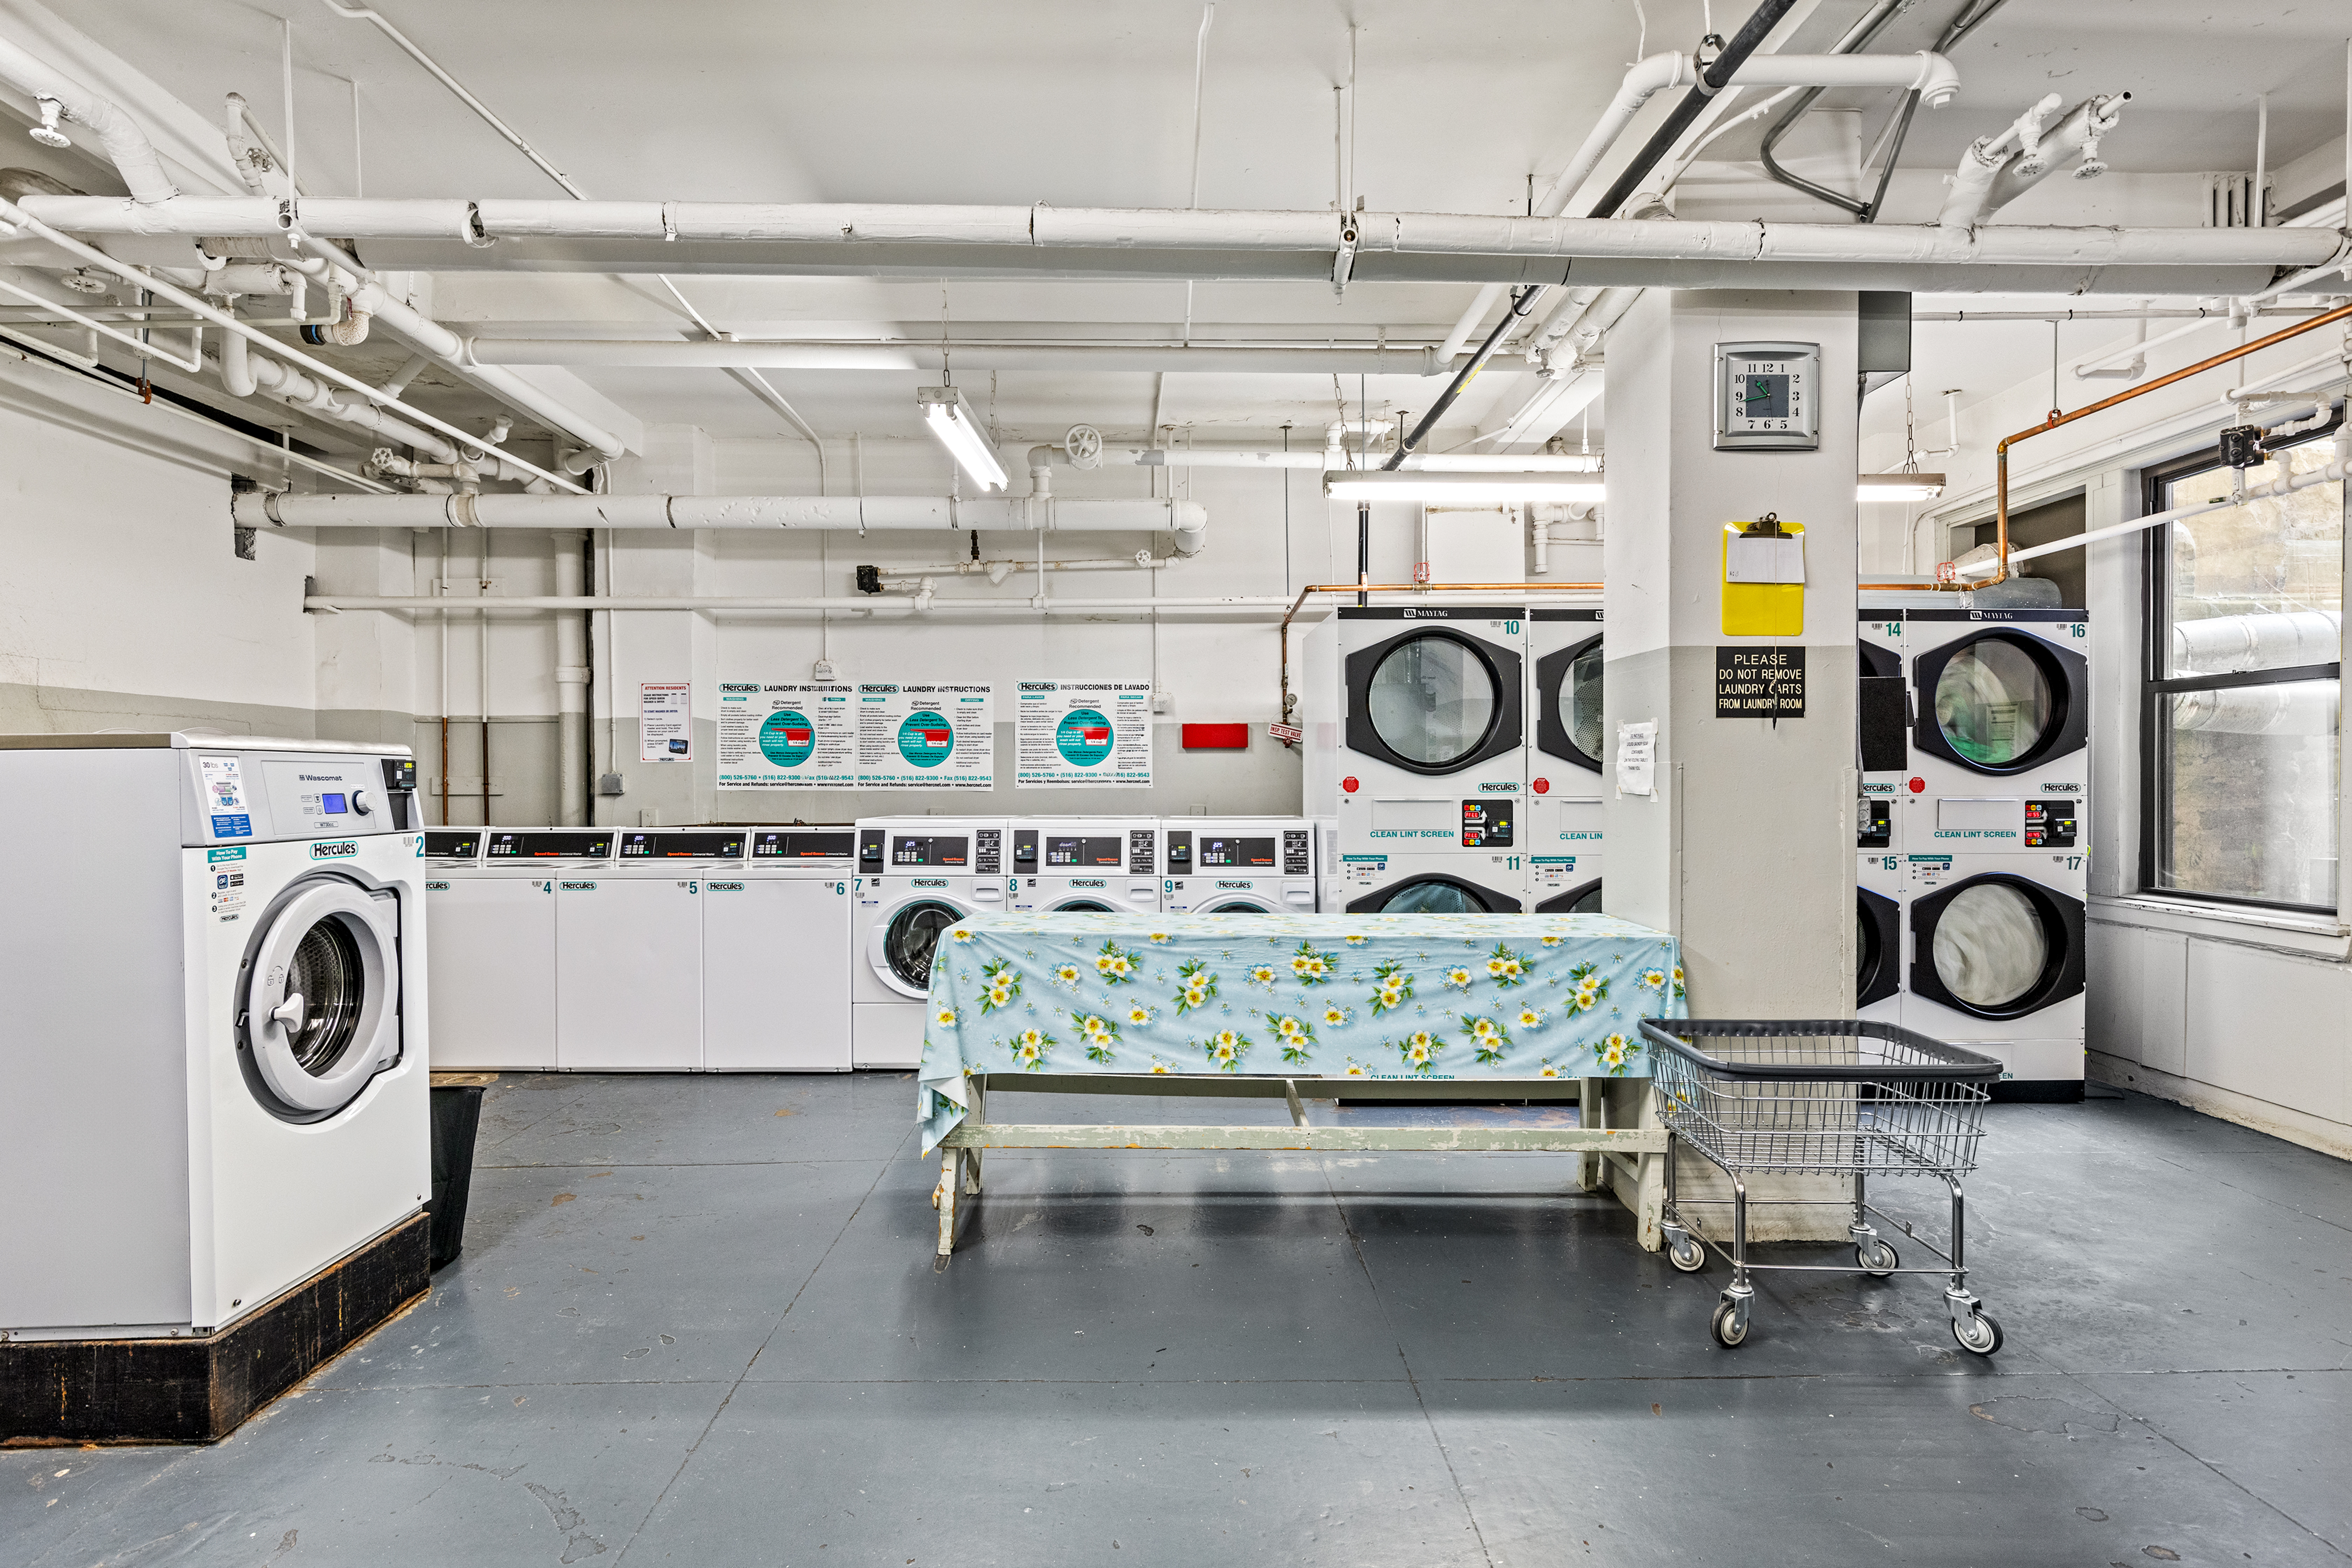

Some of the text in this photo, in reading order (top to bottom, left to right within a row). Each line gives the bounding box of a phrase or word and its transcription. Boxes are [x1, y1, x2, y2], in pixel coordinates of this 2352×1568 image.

[1748, 364, 1784, 372] 11 12 1
[1735, 374, 1800, 383] 10 2
[1736, 392, 1799, 401] 9 3
[1736, 407, 1799, 417] 8 4
[1748, 420, 1787, 429] 7 6 5
[1504, 621, 1519, 634] 10
[1886, 623, 1901, 636] 14
[2070, 624, 2085, 637] 16
[1735, 654, 1787, 665] PLEASE
[1719, 669, 1802, 680] DO NOT REMOVE
[1719, 684, 1765, 694] LAUNDRY
[1719, 698, 1802, 709] FROM LAUNDR ROOM
[2044, 783, 2079, 791] Hercules
[315, 842, 355, 856] Hercules
[416, 836, 424, 858] 2
[1507, 857, 1519, 870] 11
[1882, 856, 1897, 870] 15
[2066, 856, 2081, 870] 17
[543, 881, 551, 894] 4
[689, 881, 697, 894] 5
[836, 882, 845, 895] 6
[854, 879, 862, 891] 7
[1009, 879, 1018, 891] 8
[1165, 880, 1173, 892] 9
